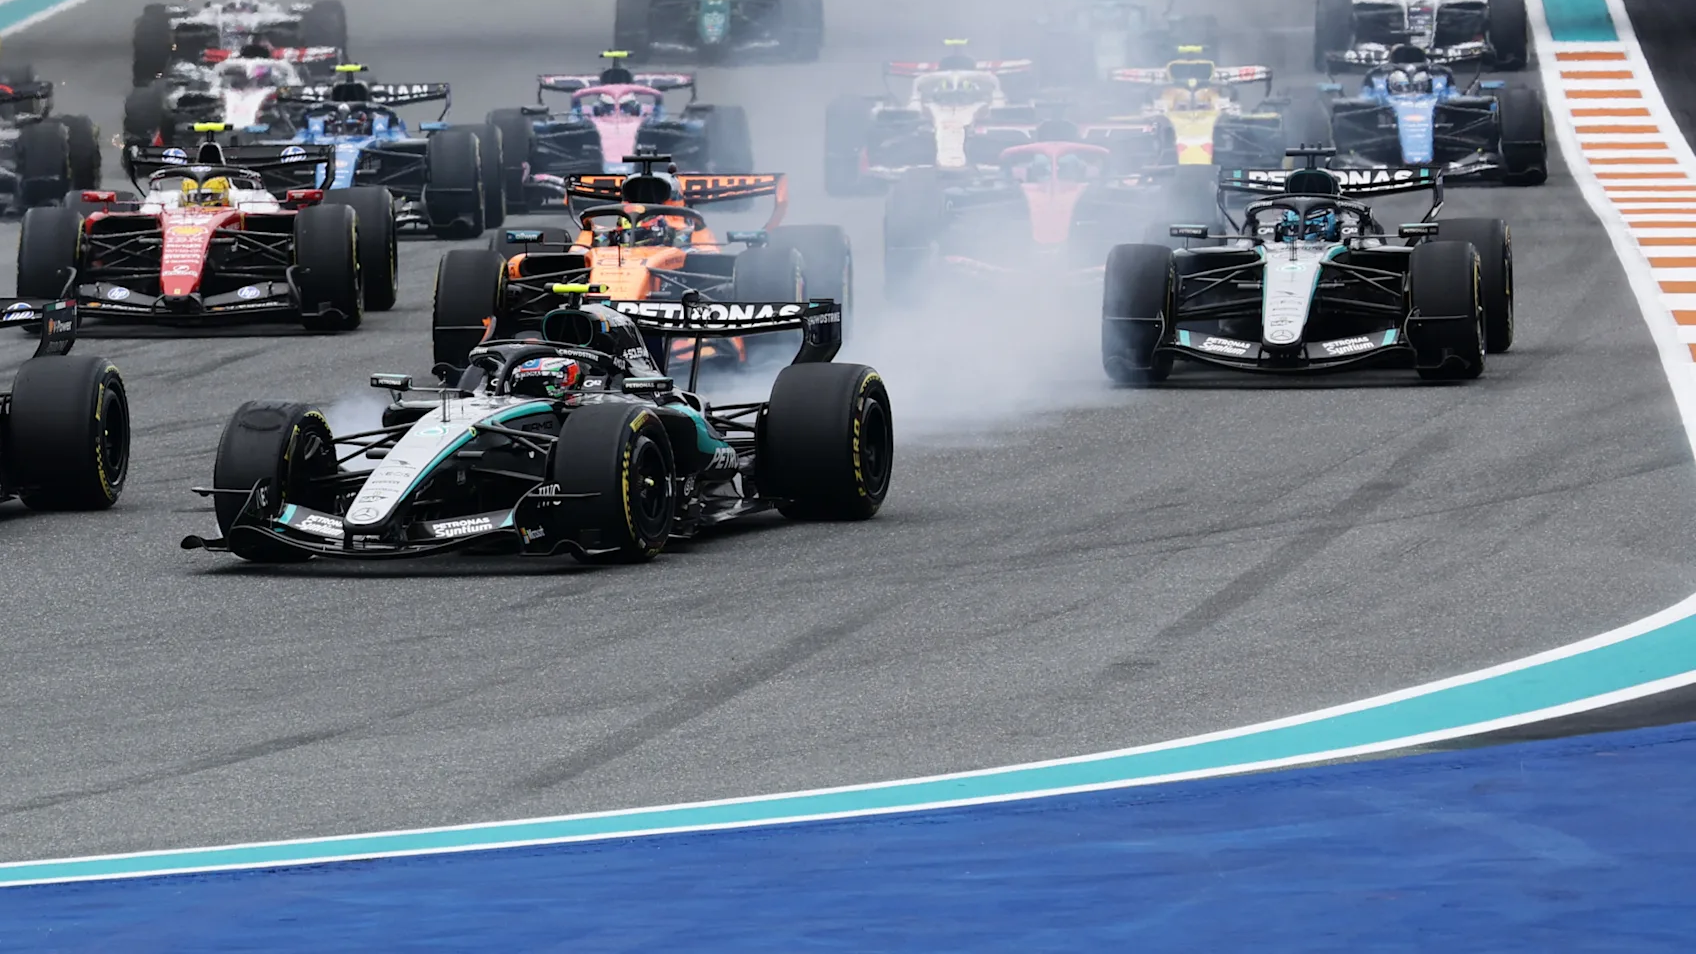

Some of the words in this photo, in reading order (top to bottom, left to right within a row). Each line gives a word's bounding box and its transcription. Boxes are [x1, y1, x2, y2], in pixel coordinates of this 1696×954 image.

[1249, 171, 1414, 191] PEONAS
[110, 287, 128, 299] hp
[241, 286, 259, 298] hp
[616, 303, 802, 329] PETRONAS
[1206, 337, 1251, 350] PETRONAS
[1322, 337, 1370, 349] PETRONAS
[1328, 342, 1375, 356] Syntium
[558, 349, 599, 362] CROWDSTRIKE
[532, 420, 553, 431] AMG
[853, 419, 863, 482] ZERO
[432, 517, 491, 531] PETRONAS
[434, 523, 494, 538] Syntium
